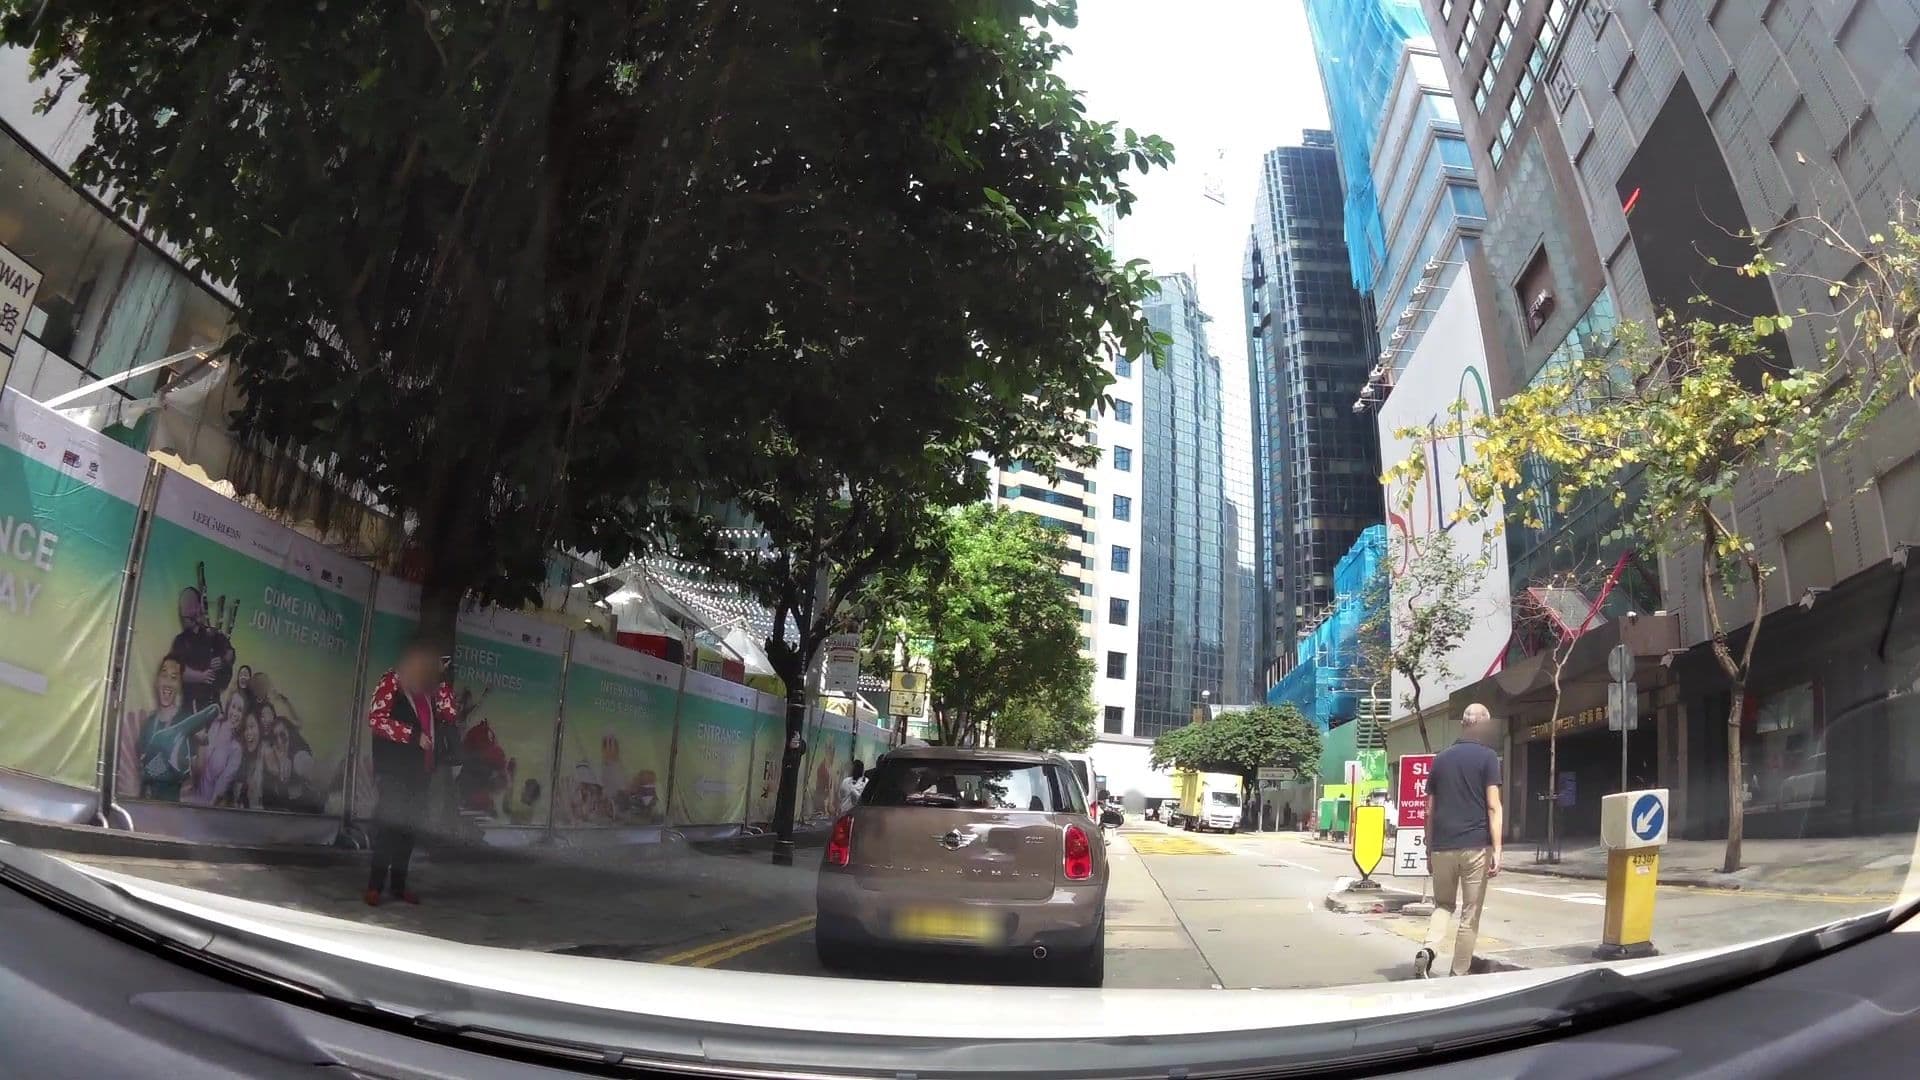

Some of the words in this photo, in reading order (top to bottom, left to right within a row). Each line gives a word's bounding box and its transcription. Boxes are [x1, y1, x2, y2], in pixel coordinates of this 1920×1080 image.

[264, 585, 301, 615] COME
[303, 599, 316, 621] IN
[318, 609, 343, 631] AND
[249, 609, 280, 636] JOIN
[284, 619, 309, 642] THE
[455, 644, 502, 668] STREET
[910, 706, 921, 715] 12
